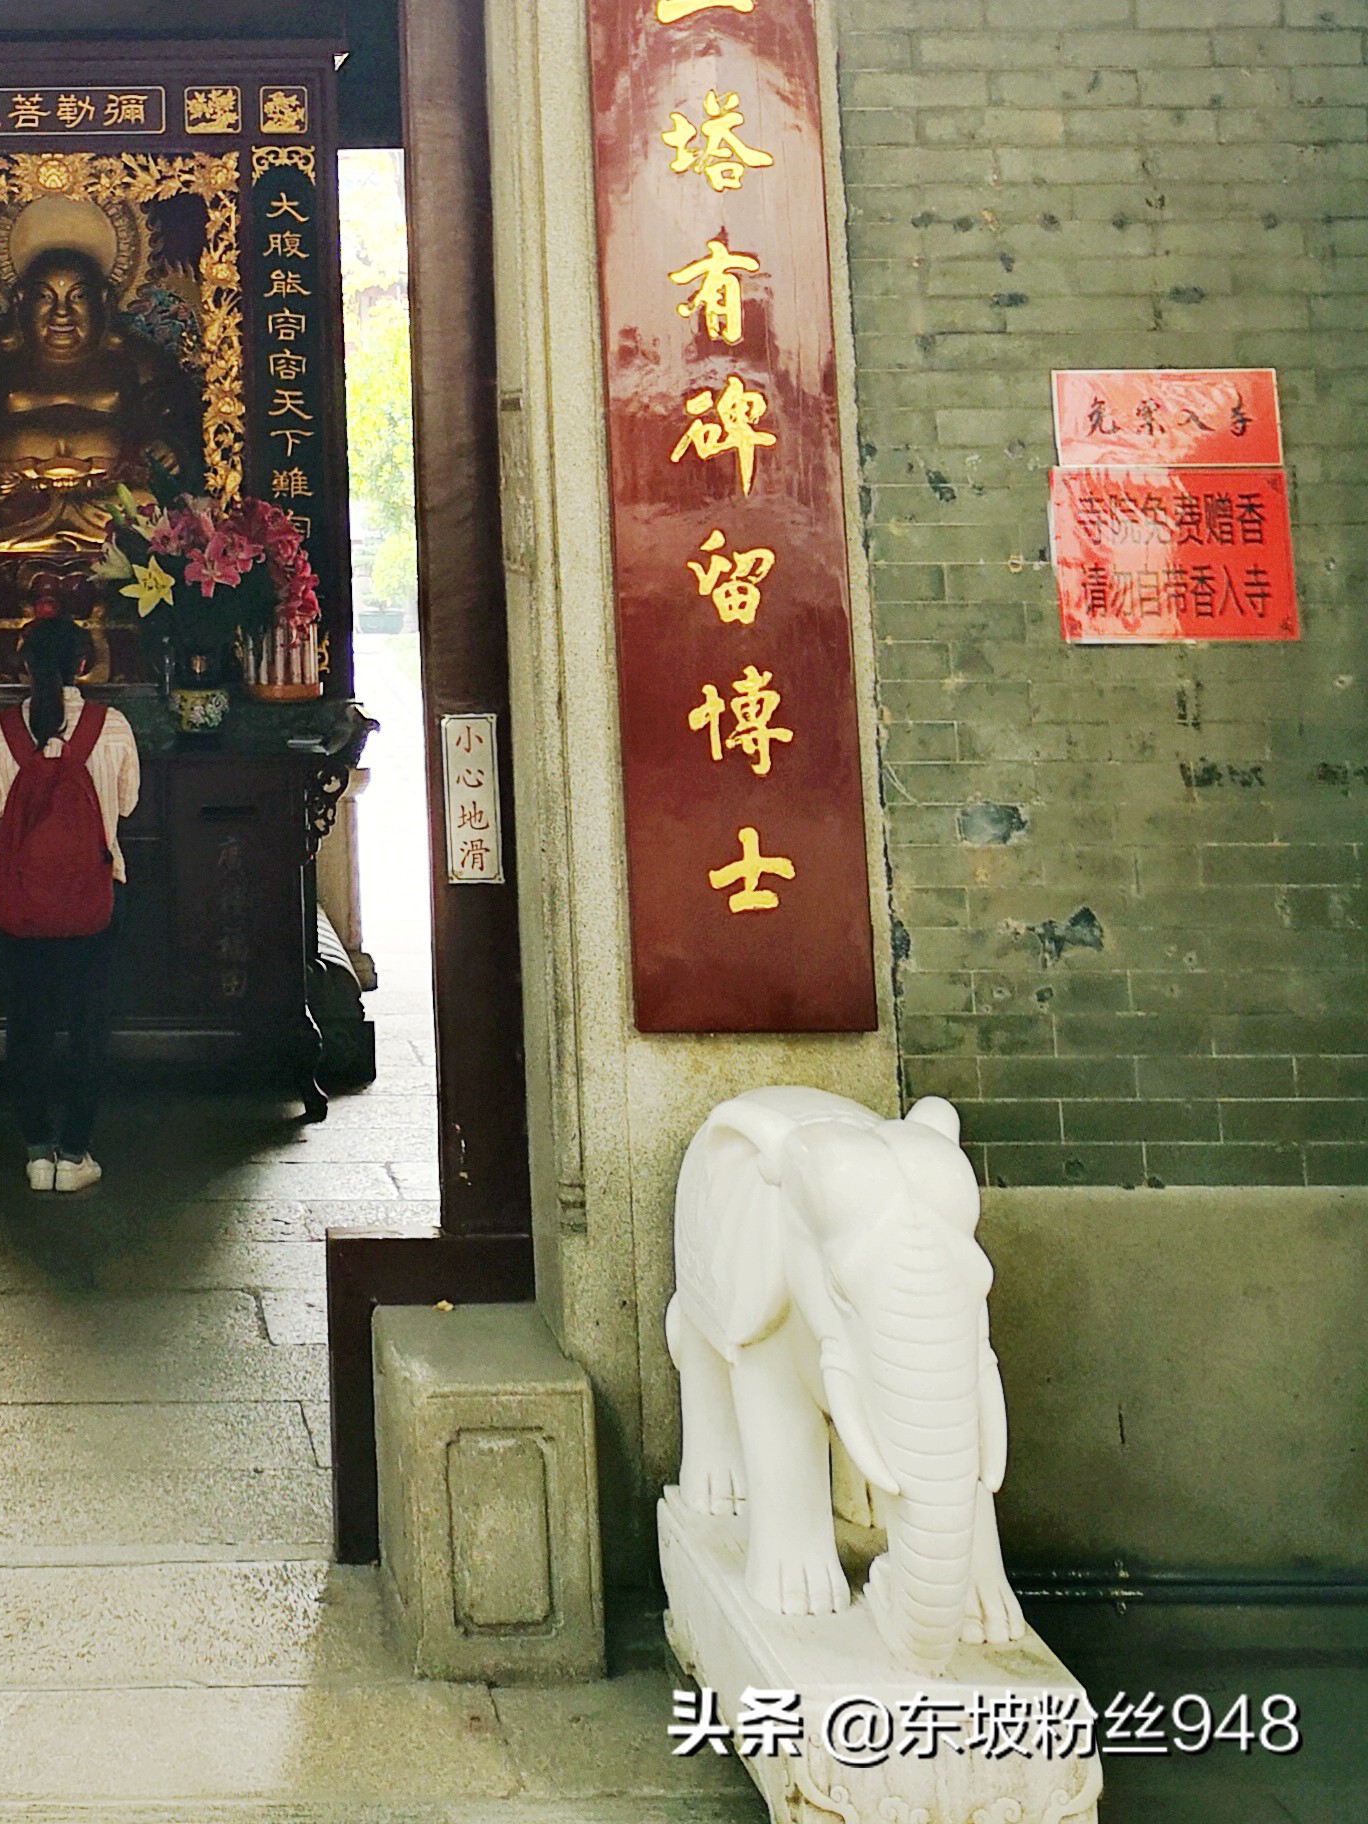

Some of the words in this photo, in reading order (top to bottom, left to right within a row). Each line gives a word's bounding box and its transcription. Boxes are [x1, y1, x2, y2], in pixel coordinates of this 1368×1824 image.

[1077, 492, 1265, 546] 寺院免费赠香
[1081, 563, 1272, 619] 请勿自带香入寺
[455, 725, 491, 872] 小心地滑
